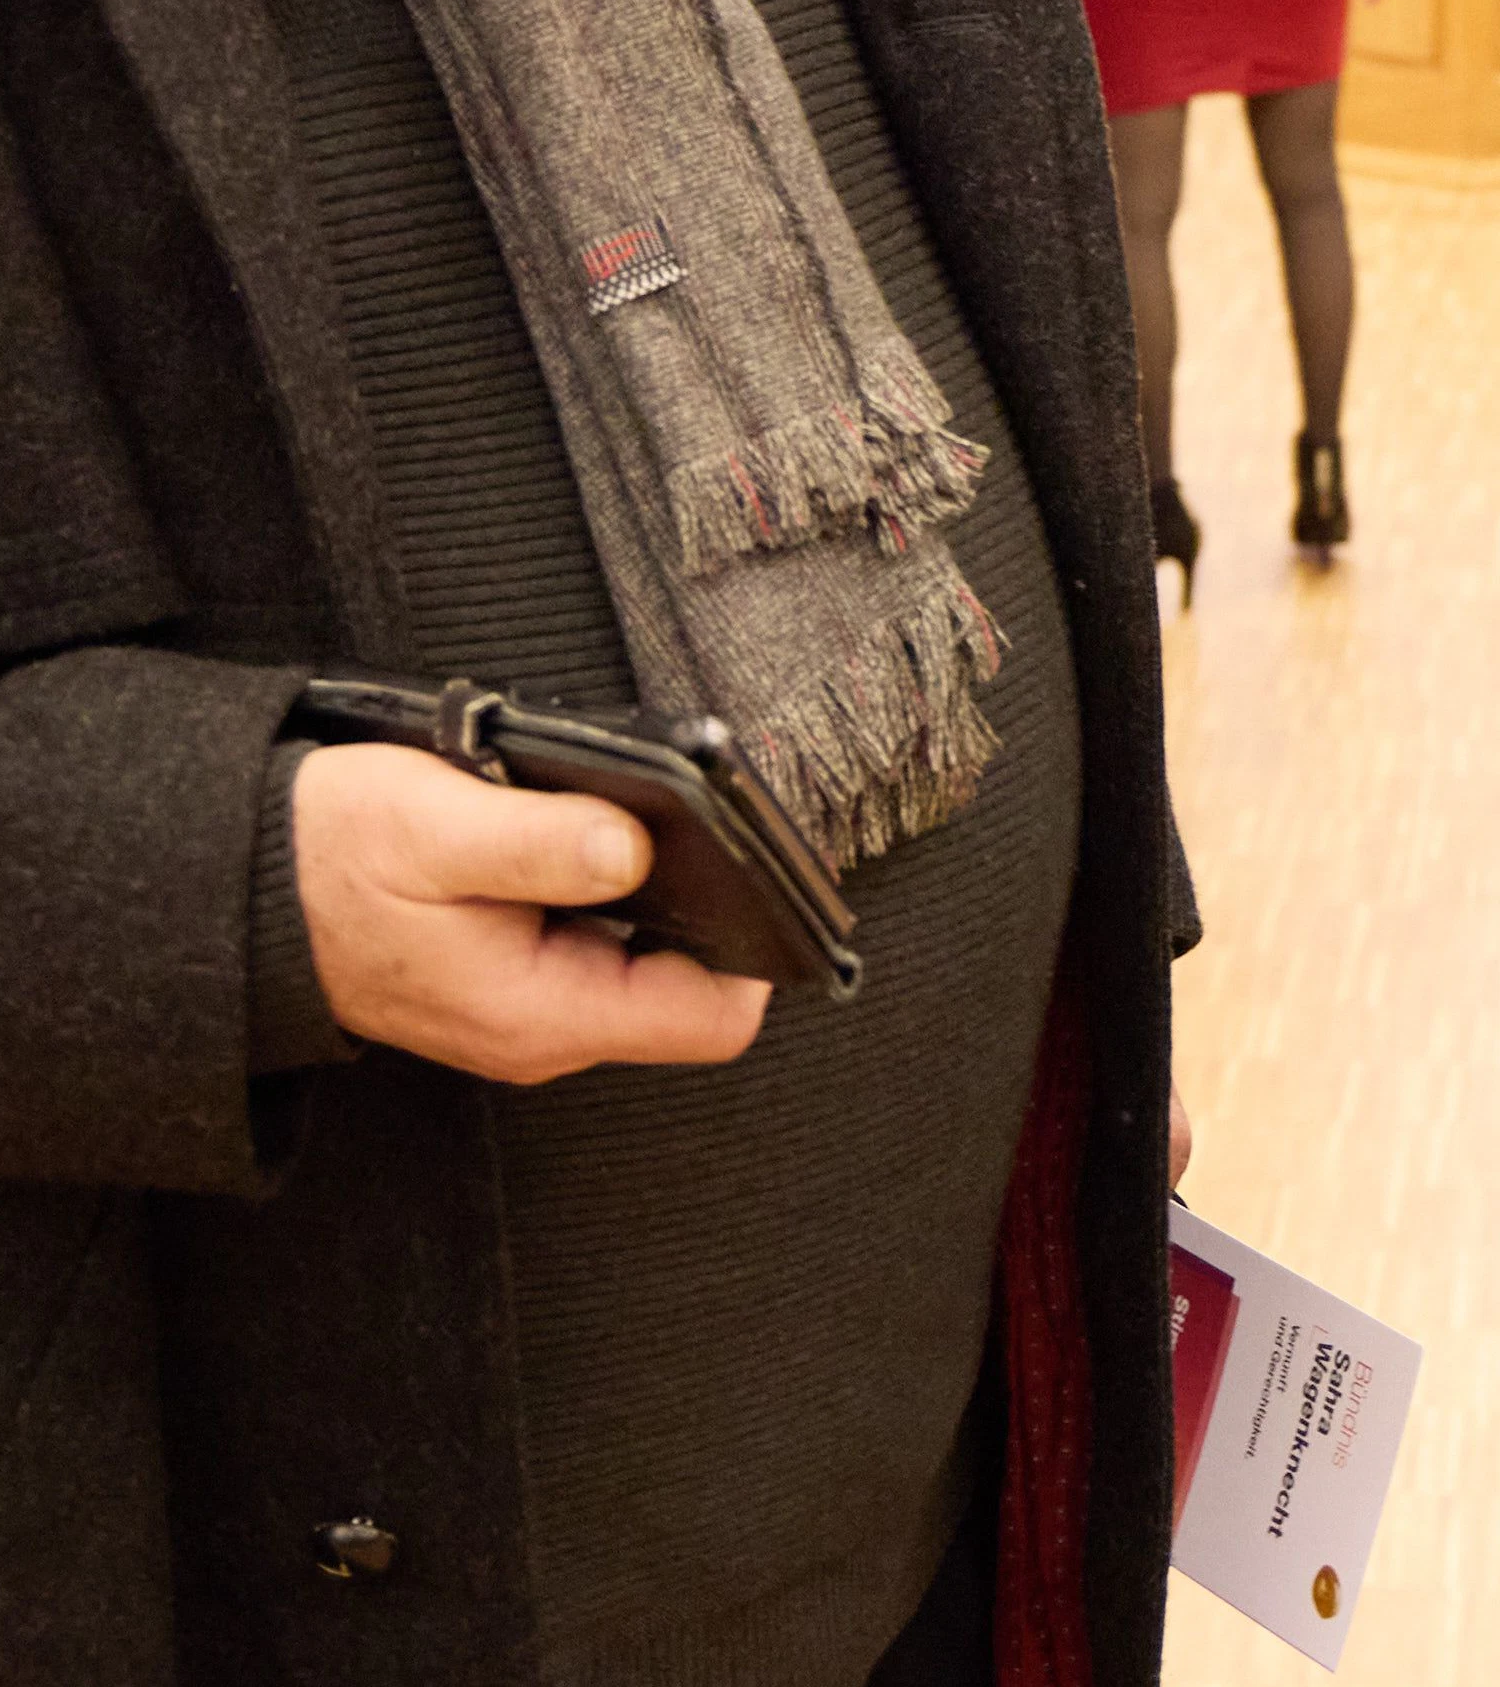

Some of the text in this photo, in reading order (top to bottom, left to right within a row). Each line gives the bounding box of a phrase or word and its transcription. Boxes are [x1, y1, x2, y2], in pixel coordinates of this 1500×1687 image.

[1271, 1315, 1288, 1353] und
[1274, 1323, 1302, 1395] Vernunft
[1315, 1347, 1352, 1437] Sahra
[1332, 1360, 1374, 1471] Bündnis
[1266, 1341, 1334, 1540] Wagenknecht
